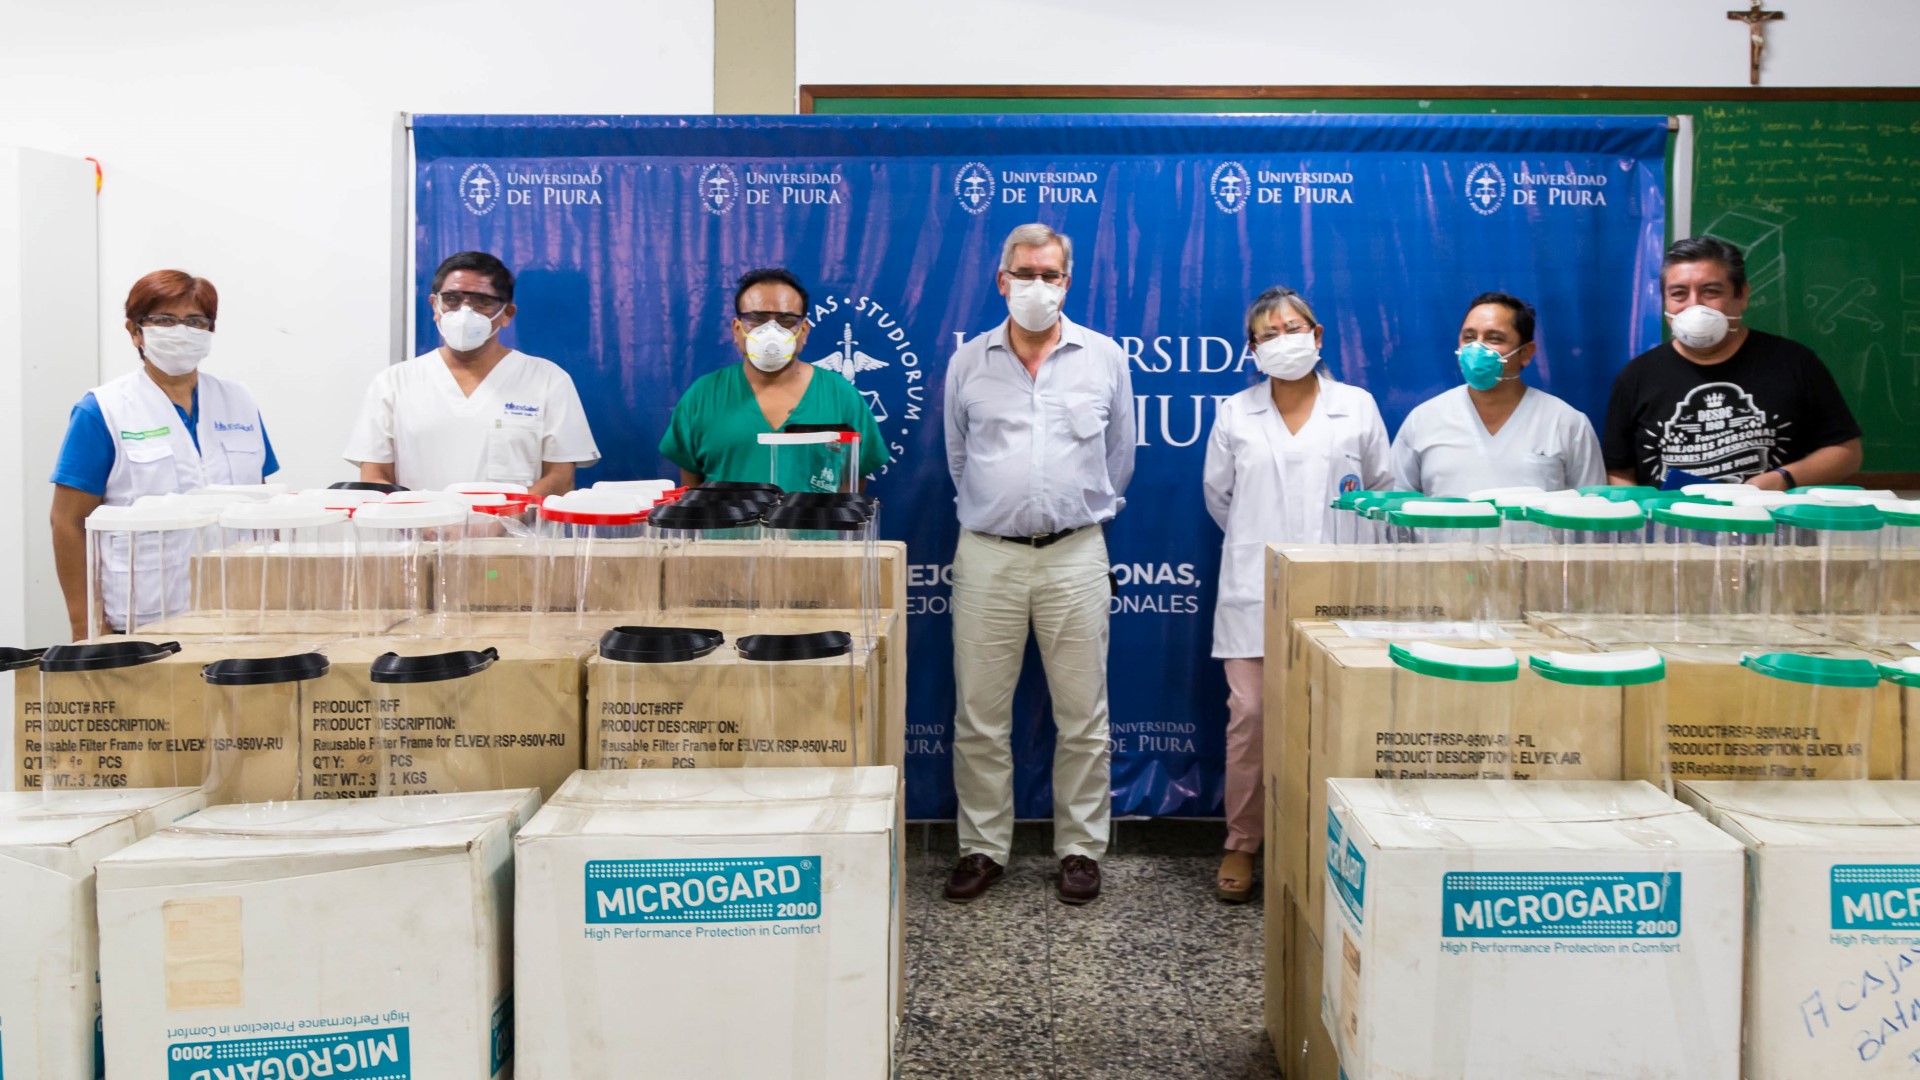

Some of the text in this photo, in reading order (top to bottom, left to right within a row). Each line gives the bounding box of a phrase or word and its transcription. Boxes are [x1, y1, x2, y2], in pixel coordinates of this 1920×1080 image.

[507, 172, 602, 185] UNIVERSIDAD
[746, 172, 841, 184] UNIVERSIDAD
[1002, 171, 1098, 183] UNIVERSIDAD
[1258, 171, 1353, 183] UNIVERSIDAD
[1513, 173, 1607, 186] UNIVERSIDAD
[507, 187, 602, 205] DE PIURA
[746, 187, 841, 204] DE PIURA
[1002, 186, 1098, 203] DE PIURA
[1258, 186, 1353, 204] DE PIURA
[1513, 188, 1607, 206] DE PIURA
[856, 296, 924, 420] STUDIORUM
[1698, 406, 1734, 421] DESDE
[1666, 428, 1777, 454] MEJORES PERSONAS
[1110, 562, 1201, 588] ONAS,
[25, 719, 170, 732] PRODUCT DESCRIPTION:
[313, 717, 456, 731] PRODUCT DESCRIPTION:
[601, 719, 655, 733] PRODUCT
[80, 739, 107, 751] Filter
[110, 738, 143, 751] Frame
[147, 738, 162, 751] for
[166, 739, 205, 752] ELVEX
[400, 736, 433, 749] Frame
[436, 735, 451, 749] for
[455, 735, 490, 748] ELVEX
[493, 734, 565, 748] RSP-950V-RU
[601, 739, 650, 752] Reusable
[652, 739, 680, 752] Filter
[682, 739, 717, 752] Frame
[719, 739, 734, 752] for
[777, 739, 847, 753] RSP-950V-RU
[905, 739, 945, 754] URA
[1138, 735, 1196, 753] PIURA
[1667, 742, 1722, 755] PRODUCT
[98, 756, 122, 769] PCS
[312, 755, 345, 769] QTY:
[390, 755, 413, 768] PCS
[672, 757, 695, 769] PCS
[1376, 750, 1434, 763] PRODUCT
[102, 774, 127, 787] KGS
[403, 771, 428, 784] KGS
[596, 863, 801, 919] MICROGARD
[776, 902, 818, 918] 2000
[1453, 879, 1662, 932] MICROGARD
[584, 923, 821, 941] High Performance Protection in Comfort
[1636, 919, 1678, 935] 2000
[1440, 940, 1681, 955] High Performance Protection in Comfort
[1829, 933, 1858, 948] High
[167, 1011, 410, 1039] High Performance Protection in Comfort
[171, 1045, 213, 1062] 2000
